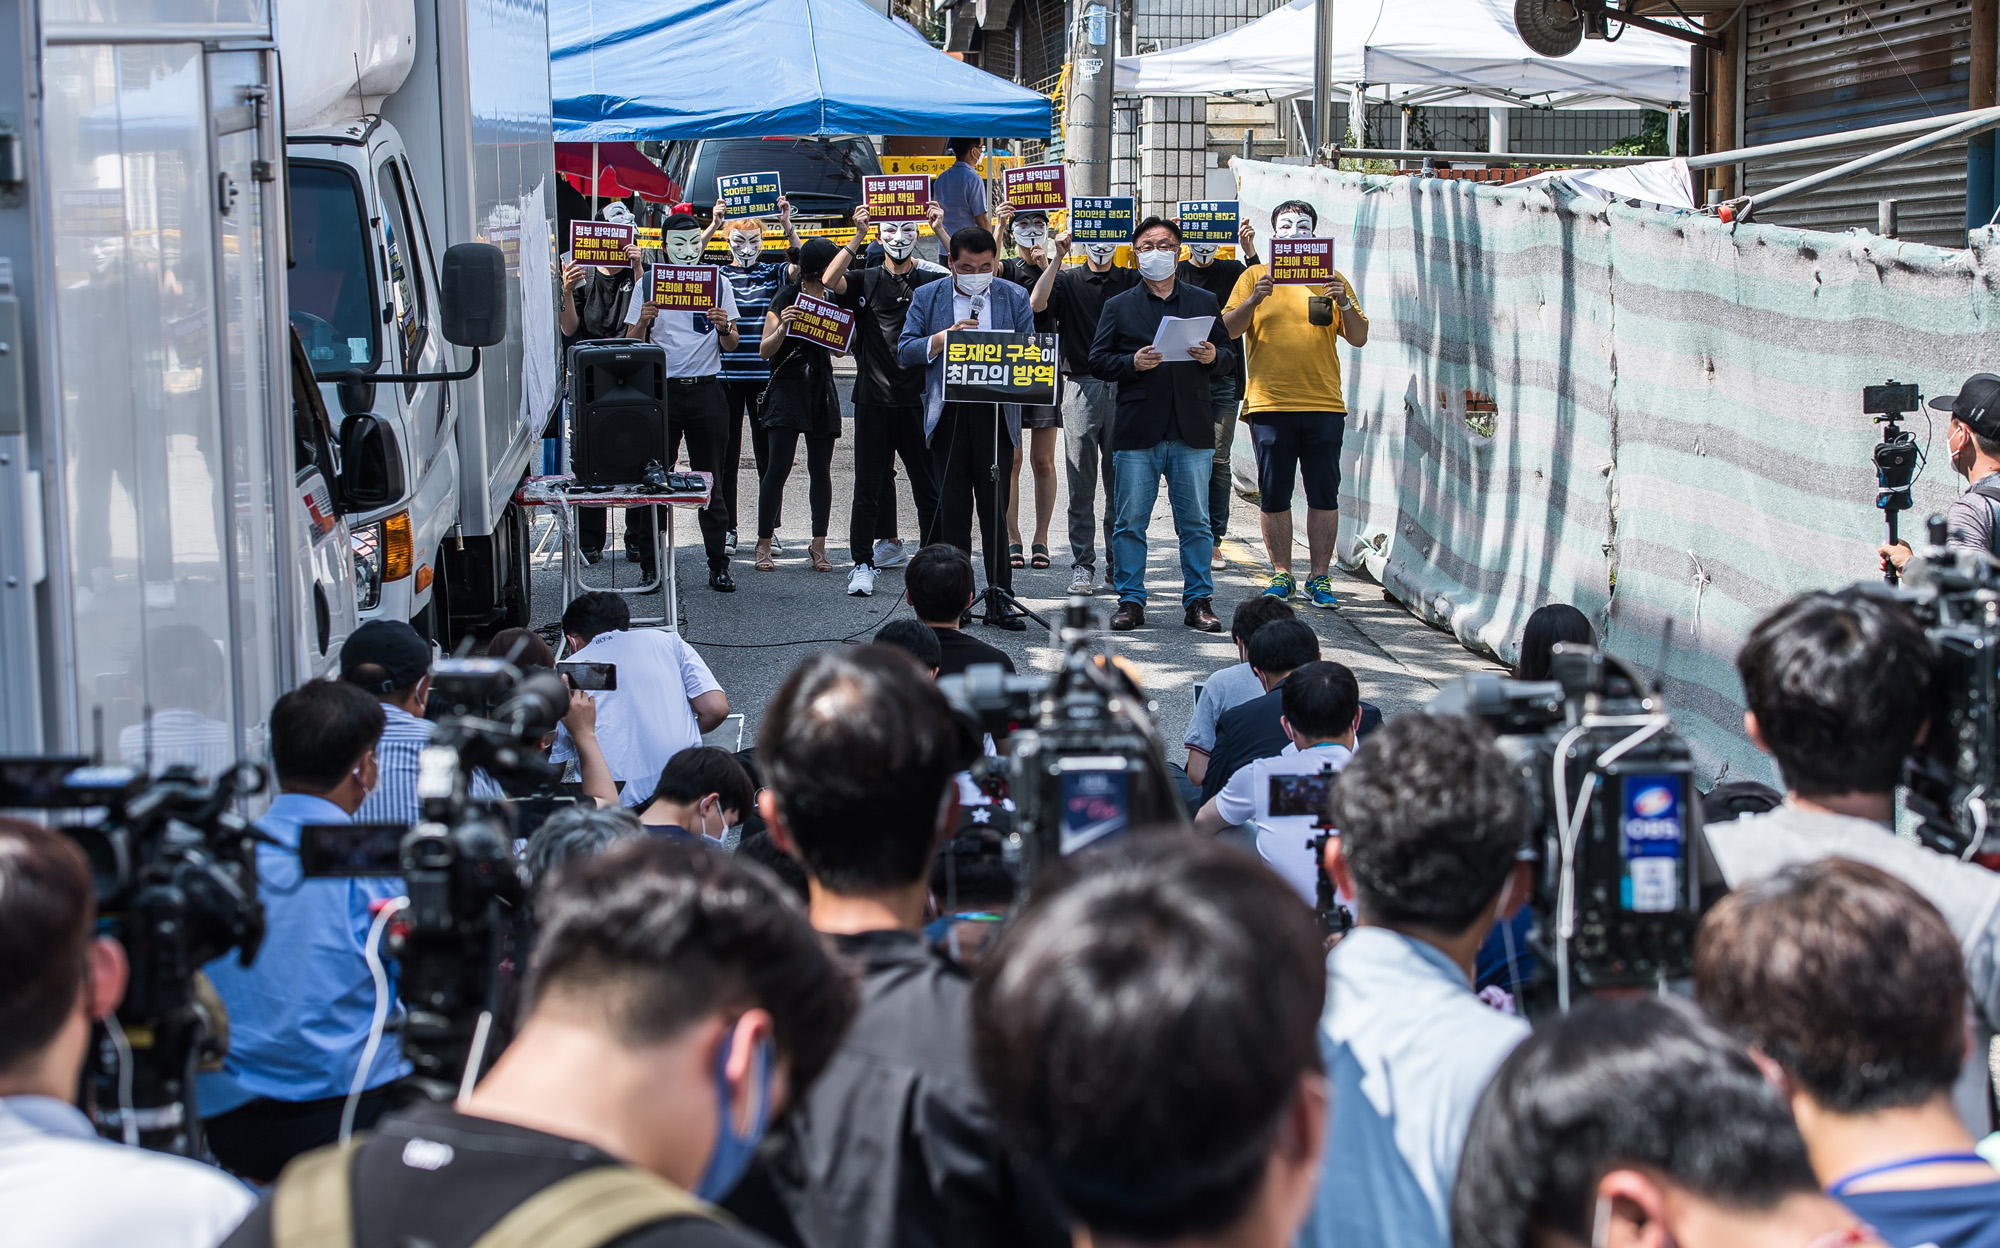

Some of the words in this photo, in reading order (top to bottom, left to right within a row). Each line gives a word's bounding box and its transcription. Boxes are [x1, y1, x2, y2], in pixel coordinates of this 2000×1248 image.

[1008, 172, 1024, 184] 정부
[1026, 169, 1060, 181] 방역실패
[723, 185, 754, 197] 300만은
[868, 180, 886, 192] 정부
[888, 179, 924, 191] 방역실패
[1009, 182, 1033, 194] 교회에
[1035, 181, 1052, 192] 책임
[869, 193, 895, 204] 교회에
[897, 192, 915, 203] 책임
[1009, 194, 1042, 206] 떠넘기지
[726, 206, 747, 215] 국민은
[869, 205, 904, 216] 떠넘기지
[1074, 210, 1106, 219] 300만은
[1182, 212, 1213, 221] 300만은
[575, 225, 592, 236] 정부
[594, 226, 628, 238] 방역실패
[1074, 229, 1097, 238] 국민은
[1182, 231, 1204, 239] 국민은
[575, 237, 600, 248] 교회에
[601, 238, 619, 249] 책임
[1274, 243, 1292, 254] 정부
[1294, 243, 1328, 254] 방역실패
[574, 250, 608, 261] 떠넘기지
[1274, 256, 1300, 266] 교회에
[1302, 255, 1320, 266] 책임
[656, 269, 675, 281] 정부
[677, 270, 712, 282] 방역실패
[1274, 268, 1308, 279] 떠넘기지
[656, 281, 683, 293] 교회에
[685, 283, 703, 294] 책임
[655, 293, 691, 306] 떠넘기지
[798, 298, 817, 312] 정부
[816, 305, 851, 325] 방역실패
[792, 321, 825, 339] 떠넘기지
[821, 318, 839, 332] 책임
[948, 343, 1002, 362] 문재인
[1006, 344, 1055, 363] 구속이
[946, 363, 1010, 386] 최고의
[1013, 365, 1055, 386] 방역
